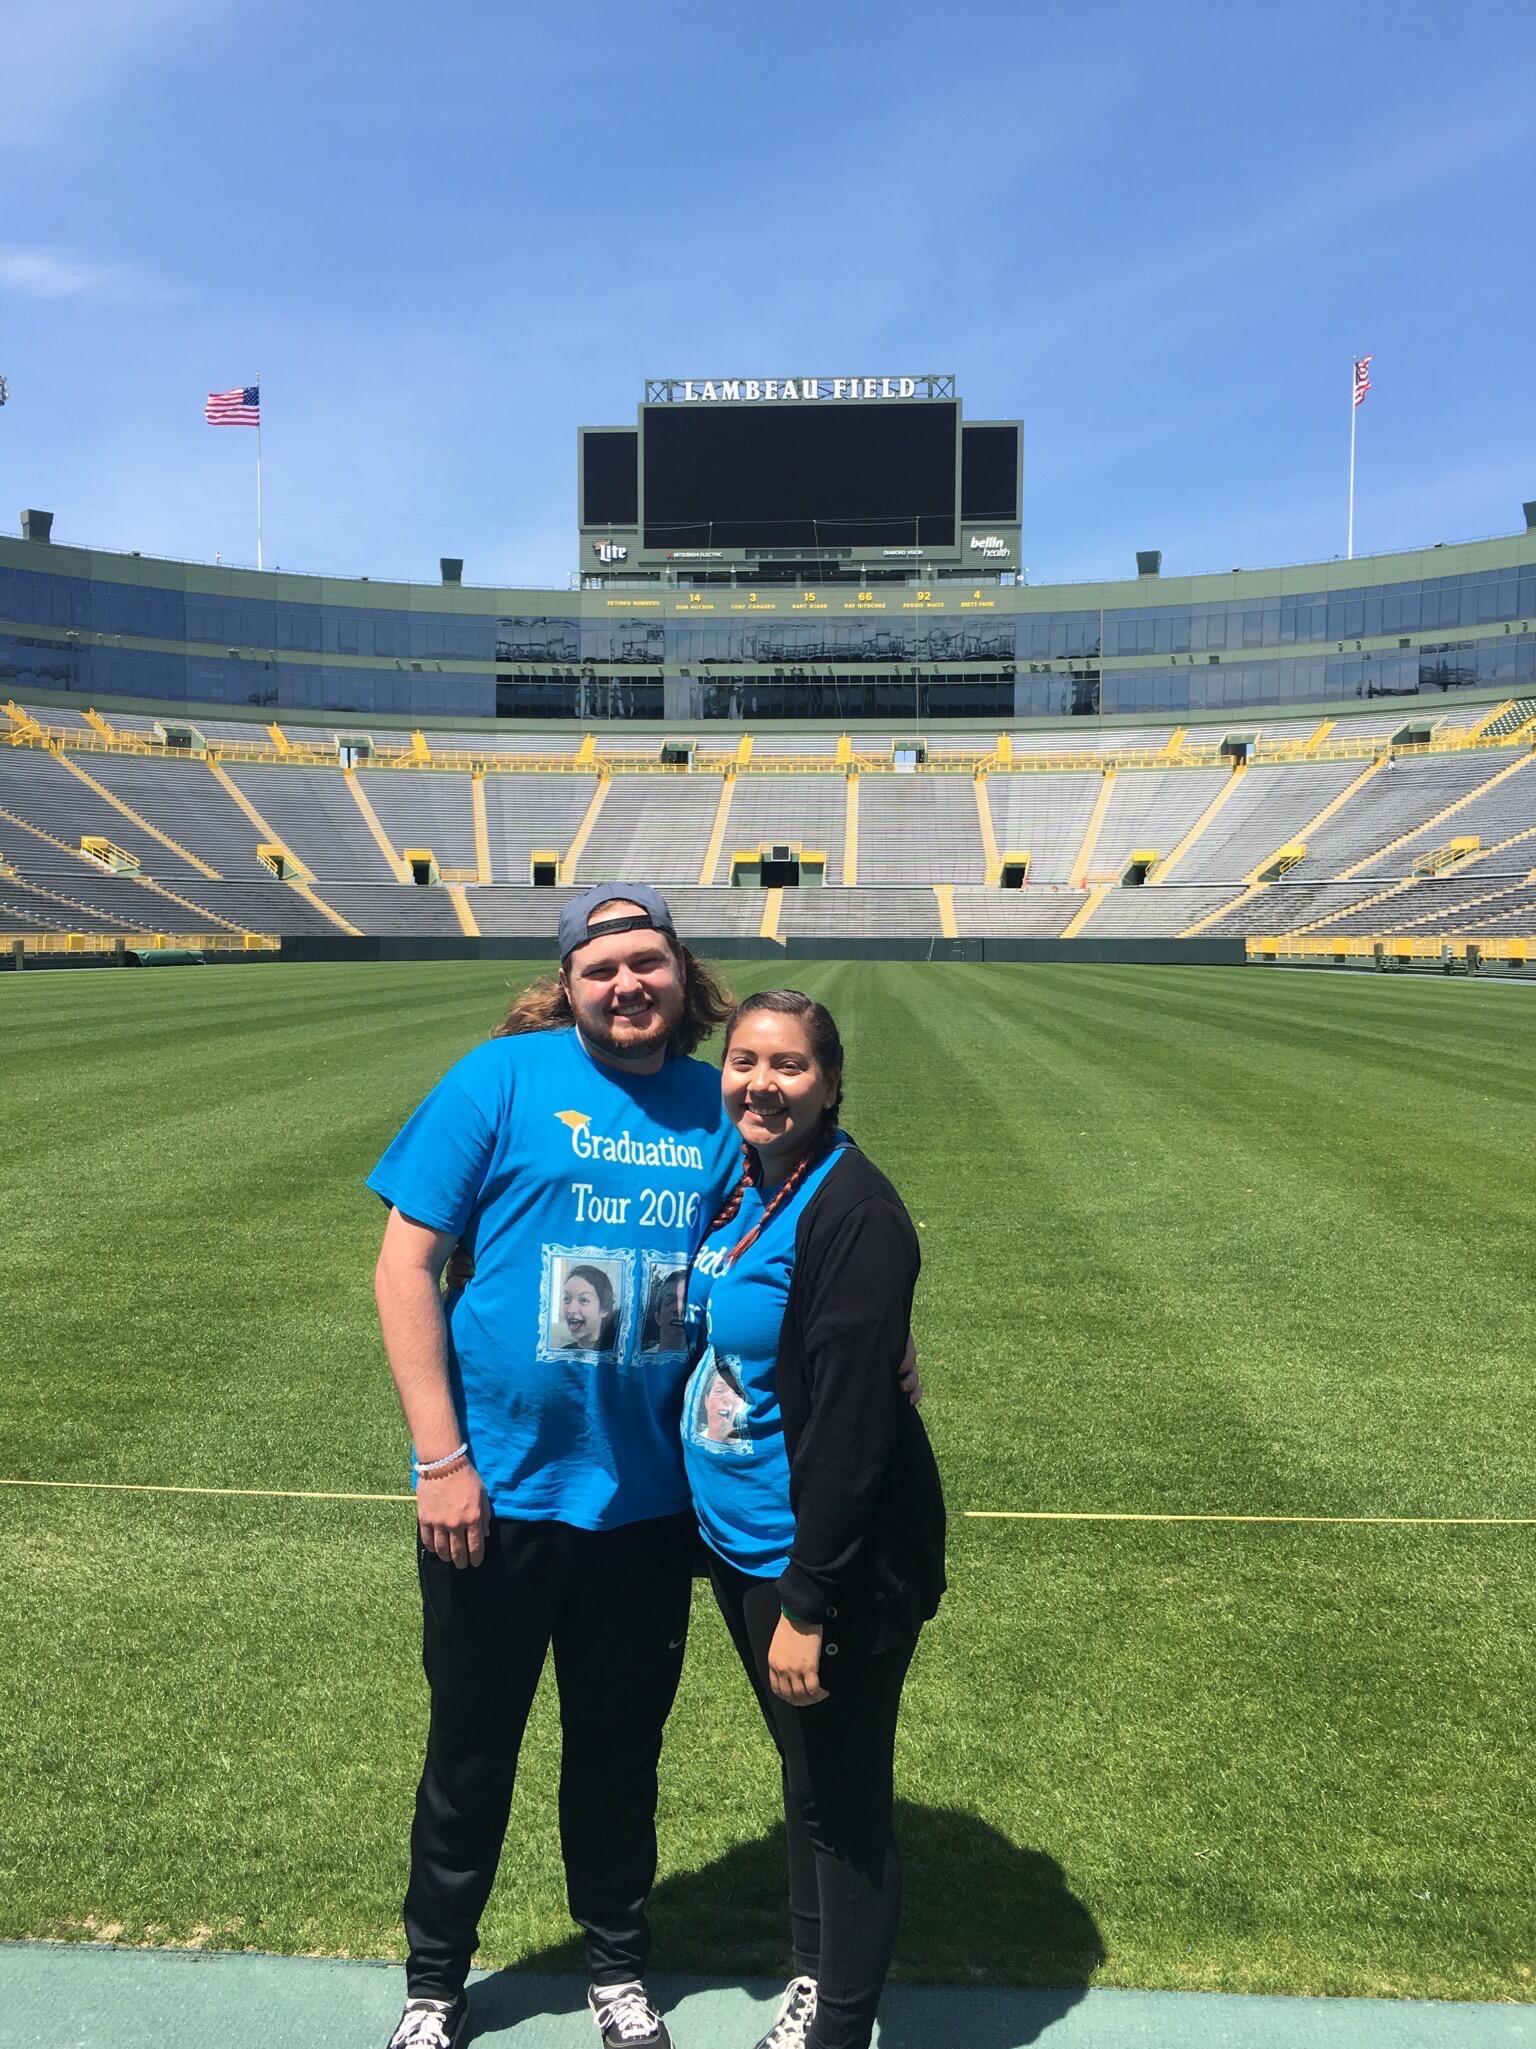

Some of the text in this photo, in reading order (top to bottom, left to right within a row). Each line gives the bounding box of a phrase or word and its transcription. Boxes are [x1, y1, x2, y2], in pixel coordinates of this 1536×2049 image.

[684, 377, 917, 401] LAMBEAU FIELD
[970, 536, 1004, 548] bellin
[600, 544, 627, 562] Lite
[982, 547, 1010, 557] health
[688, 593, 702, 603] 14
[750, 593, 757, 602] 3
[804, 592, 817, 602] 15
[858, 592, 873, 602] 66
[916, 591, 932, 601] 92
[973, 590, 981, 600] 4
[572, 1123, 704, 1170] Graduation
[571, 1183, 701, 1229] Tour 2016
